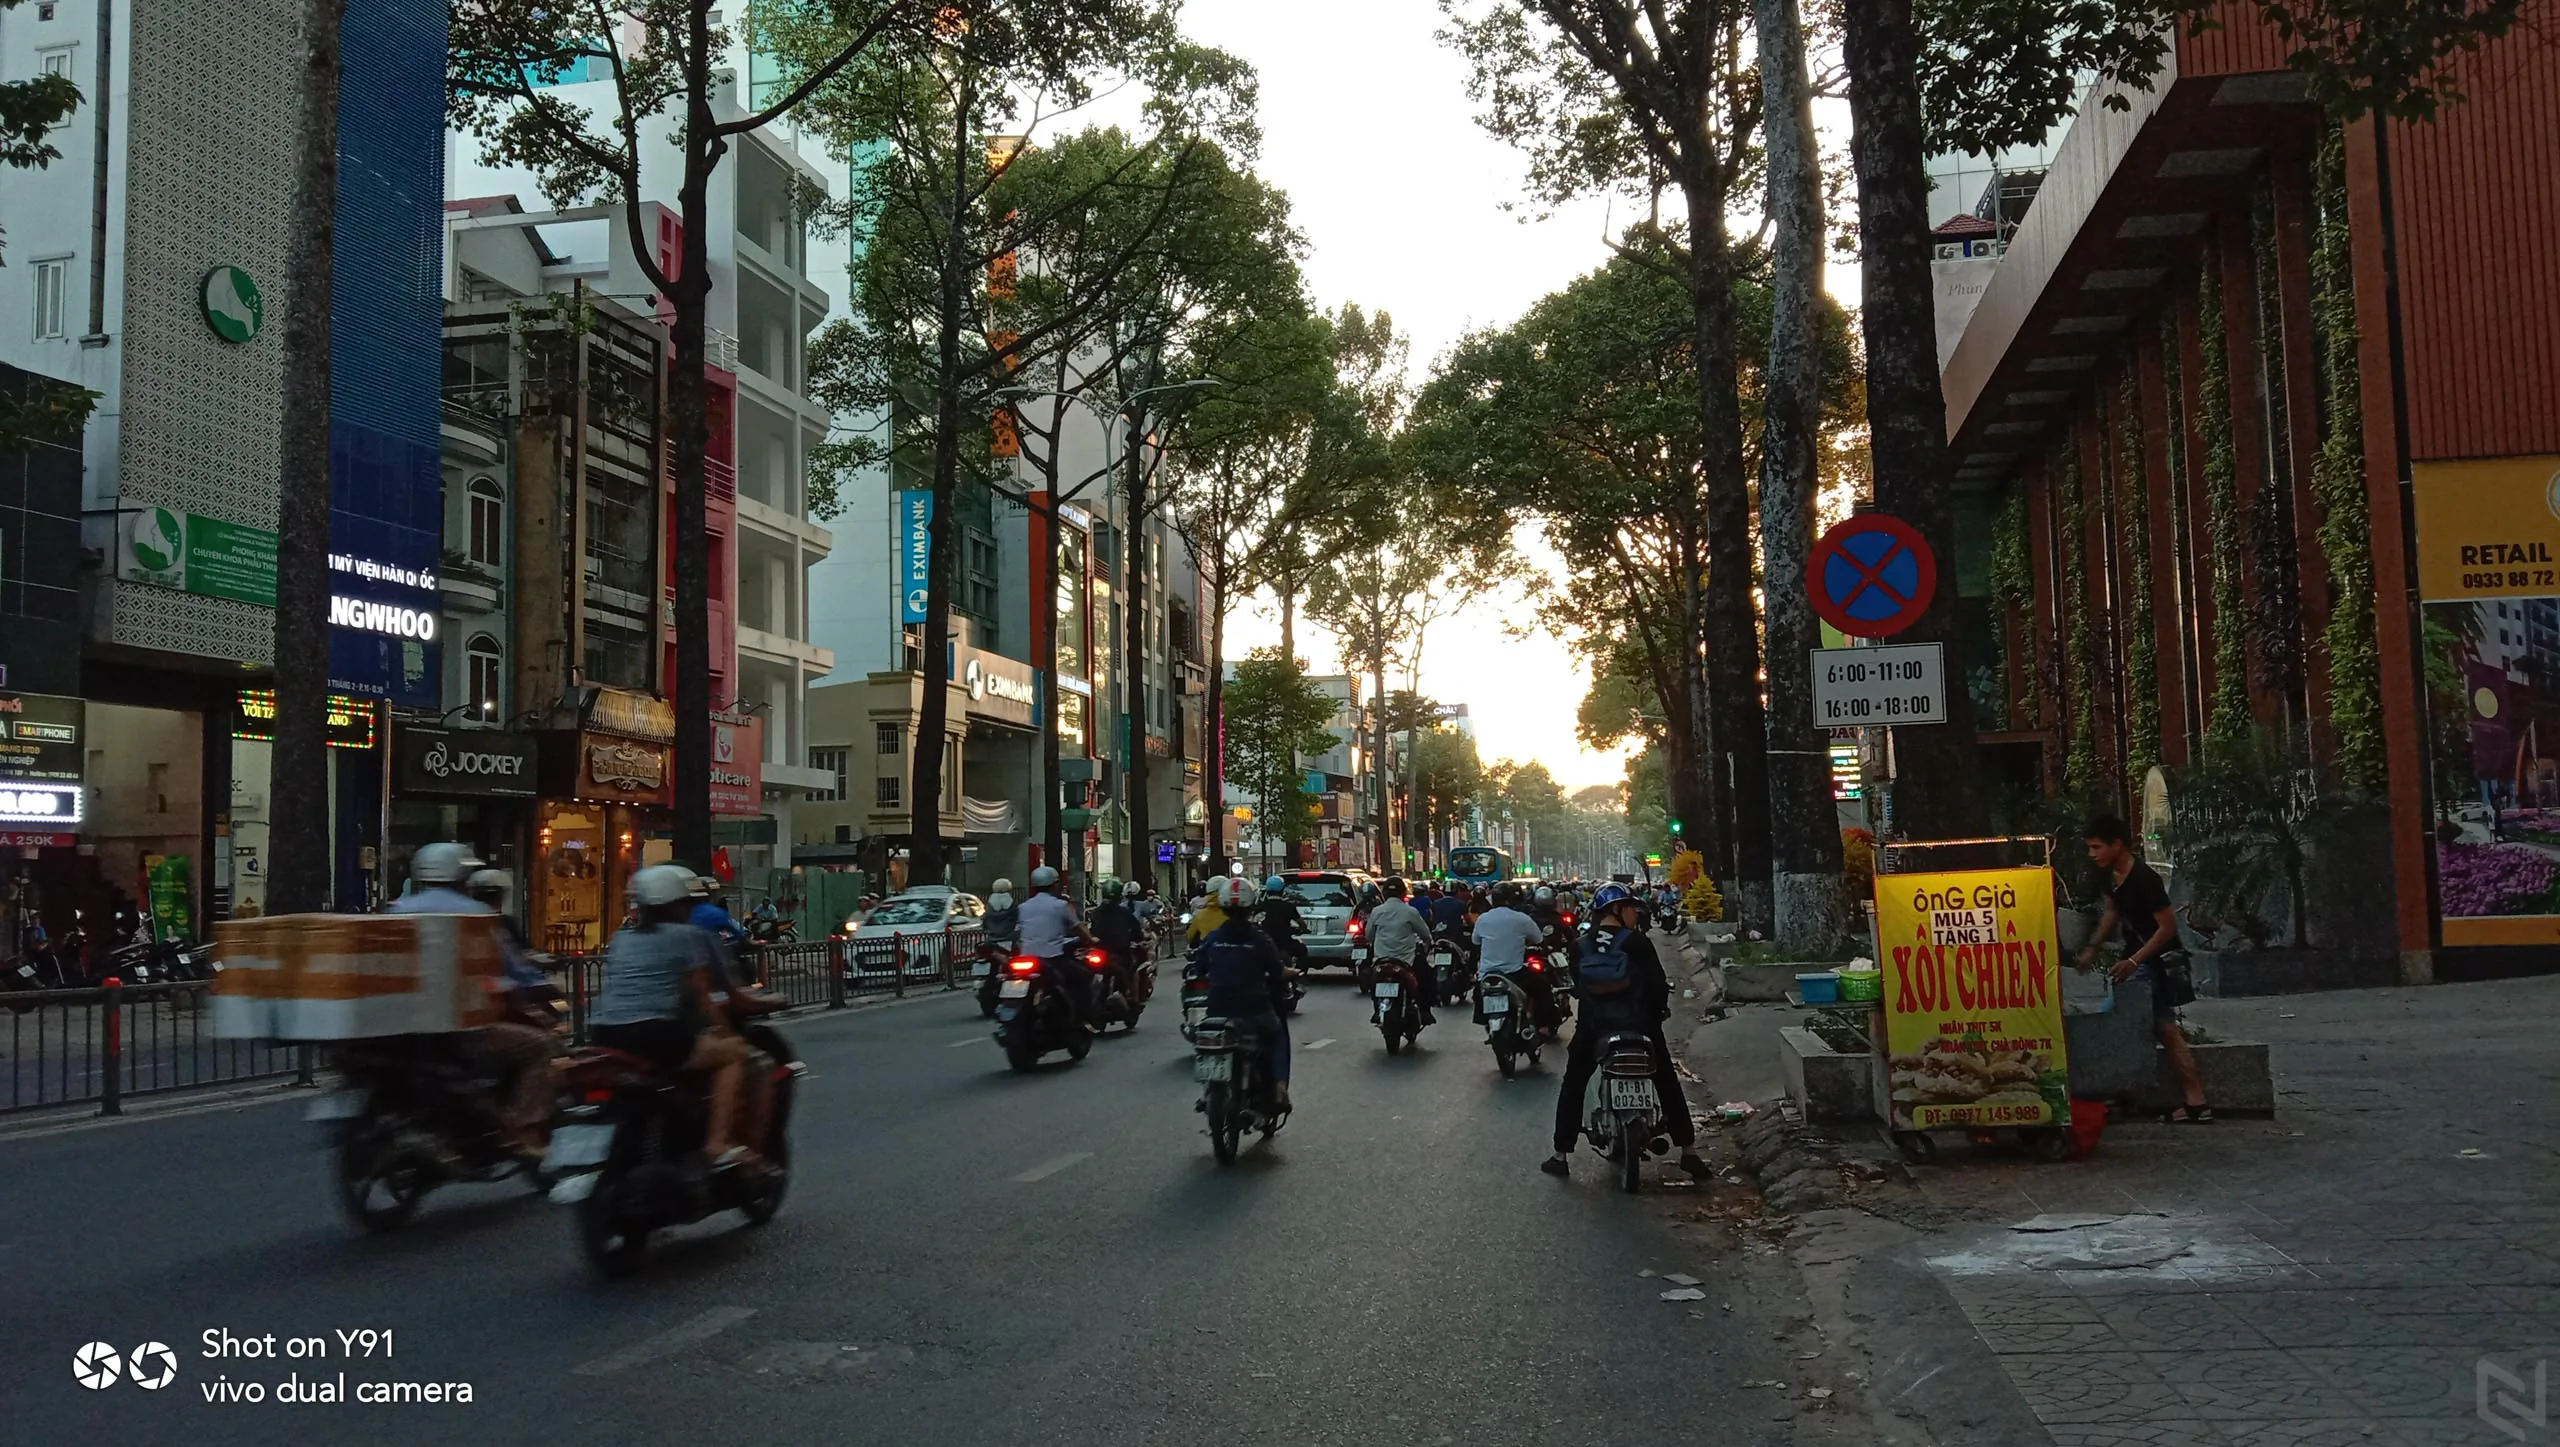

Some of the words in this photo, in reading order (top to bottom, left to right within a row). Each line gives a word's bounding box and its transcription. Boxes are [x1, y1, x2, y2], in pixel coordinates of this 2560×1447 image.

[912, 498, 926, 581] EXIMBANK
[2461, 542, 2553, 566] RETAIL
[334, 553, 353, 573] MỸ
[355, 558, 380, 582] VIỆN
[382, 563, 405, 584] HÀN
[2462, 572, 2504, 589] 0933
[2508, 571, 2529, 587] 88
[2533, 570, 2555, 586] 72
[327, 595, 434, 641] NGWHOO
[986, 673, 1034, 705] EXIMBANK
[18, 726, 71, 740] SMARTPHONE
[450, 751, 524, 775] JOCKEY
[16, 835, 53, 846] 250K
[1913, 886, 1966, 913] ônG
[1973, 882, 2017, 909] Già
[1935, 911, 1976, 927] MUA
[1983, 910, 1994, 925] 5
[1934, 926, 1980, 949] TẶNG
[1987, 928, 1997, 943] 1
[1892, 922, 1951, 1013] XÔI
[1955, 919, 2048, 1011] CHIÊN
[1989, 1020, 2002, 1033] 5K
[1950, 1107, 1982, 1122] 0977
[1987, 1107, 2012, 1121] 145
[2015, 1105, 2040, 1121] 989
